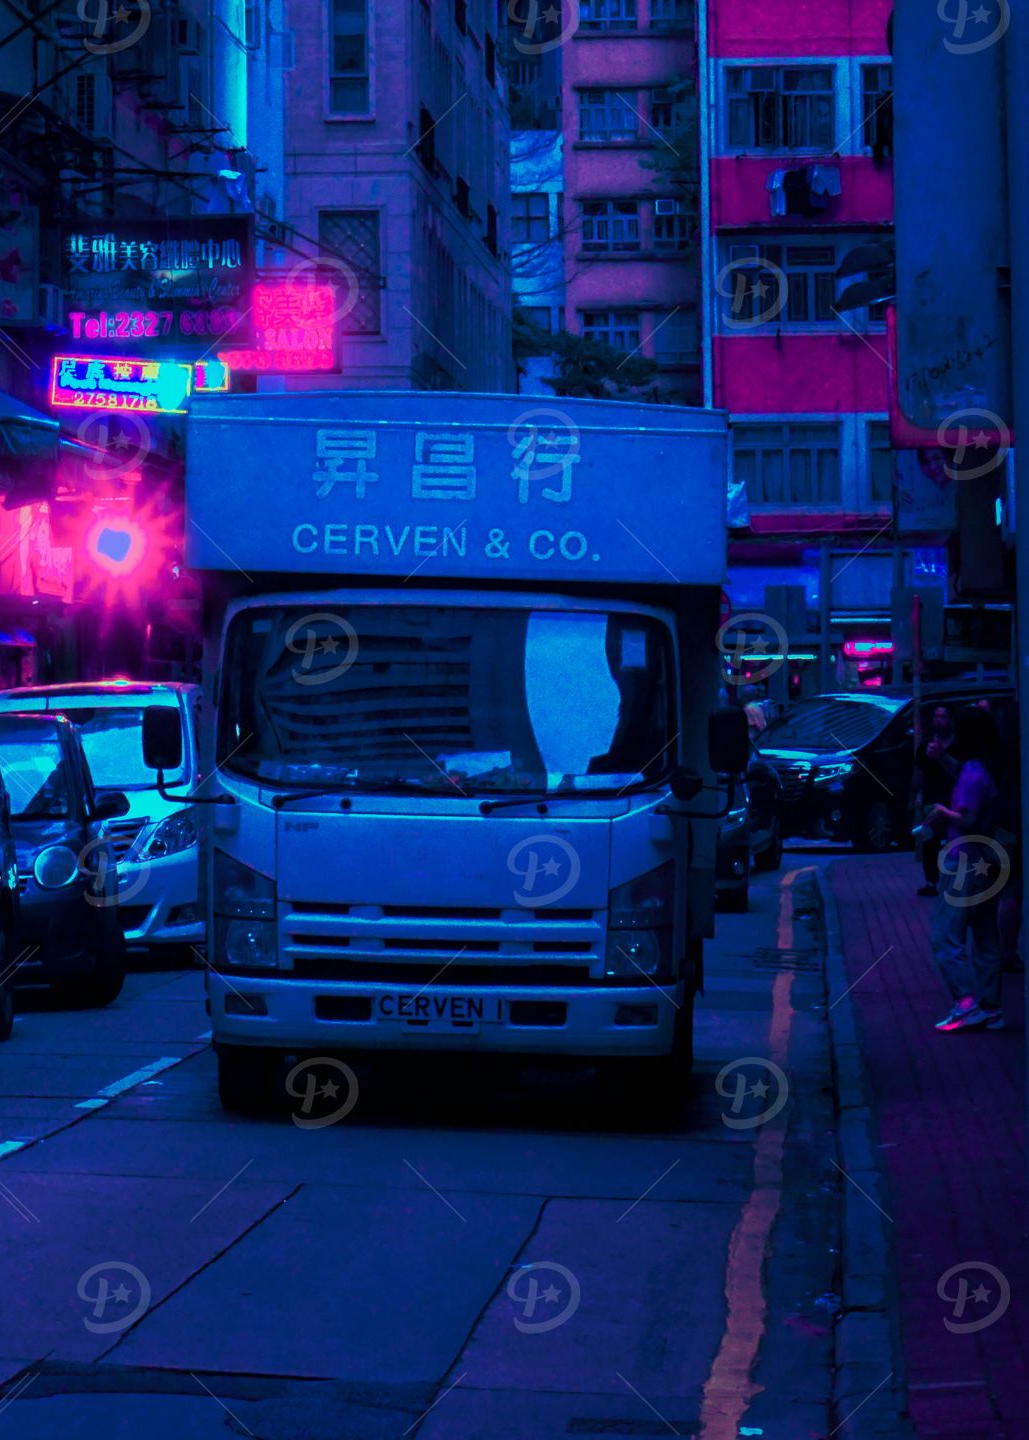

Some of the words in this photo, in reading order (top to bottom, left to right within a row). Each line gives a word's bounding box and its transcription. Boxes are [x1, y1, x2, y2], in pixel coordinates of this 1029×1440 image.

[312, 429, 581, 503] 昇昌行
[292, 523, 467, 558] CERVEN
[485, 529, 510, 559] &
[528, 529, 601, 562] CO.
[379, 994, 484, 1018] CERVEN
